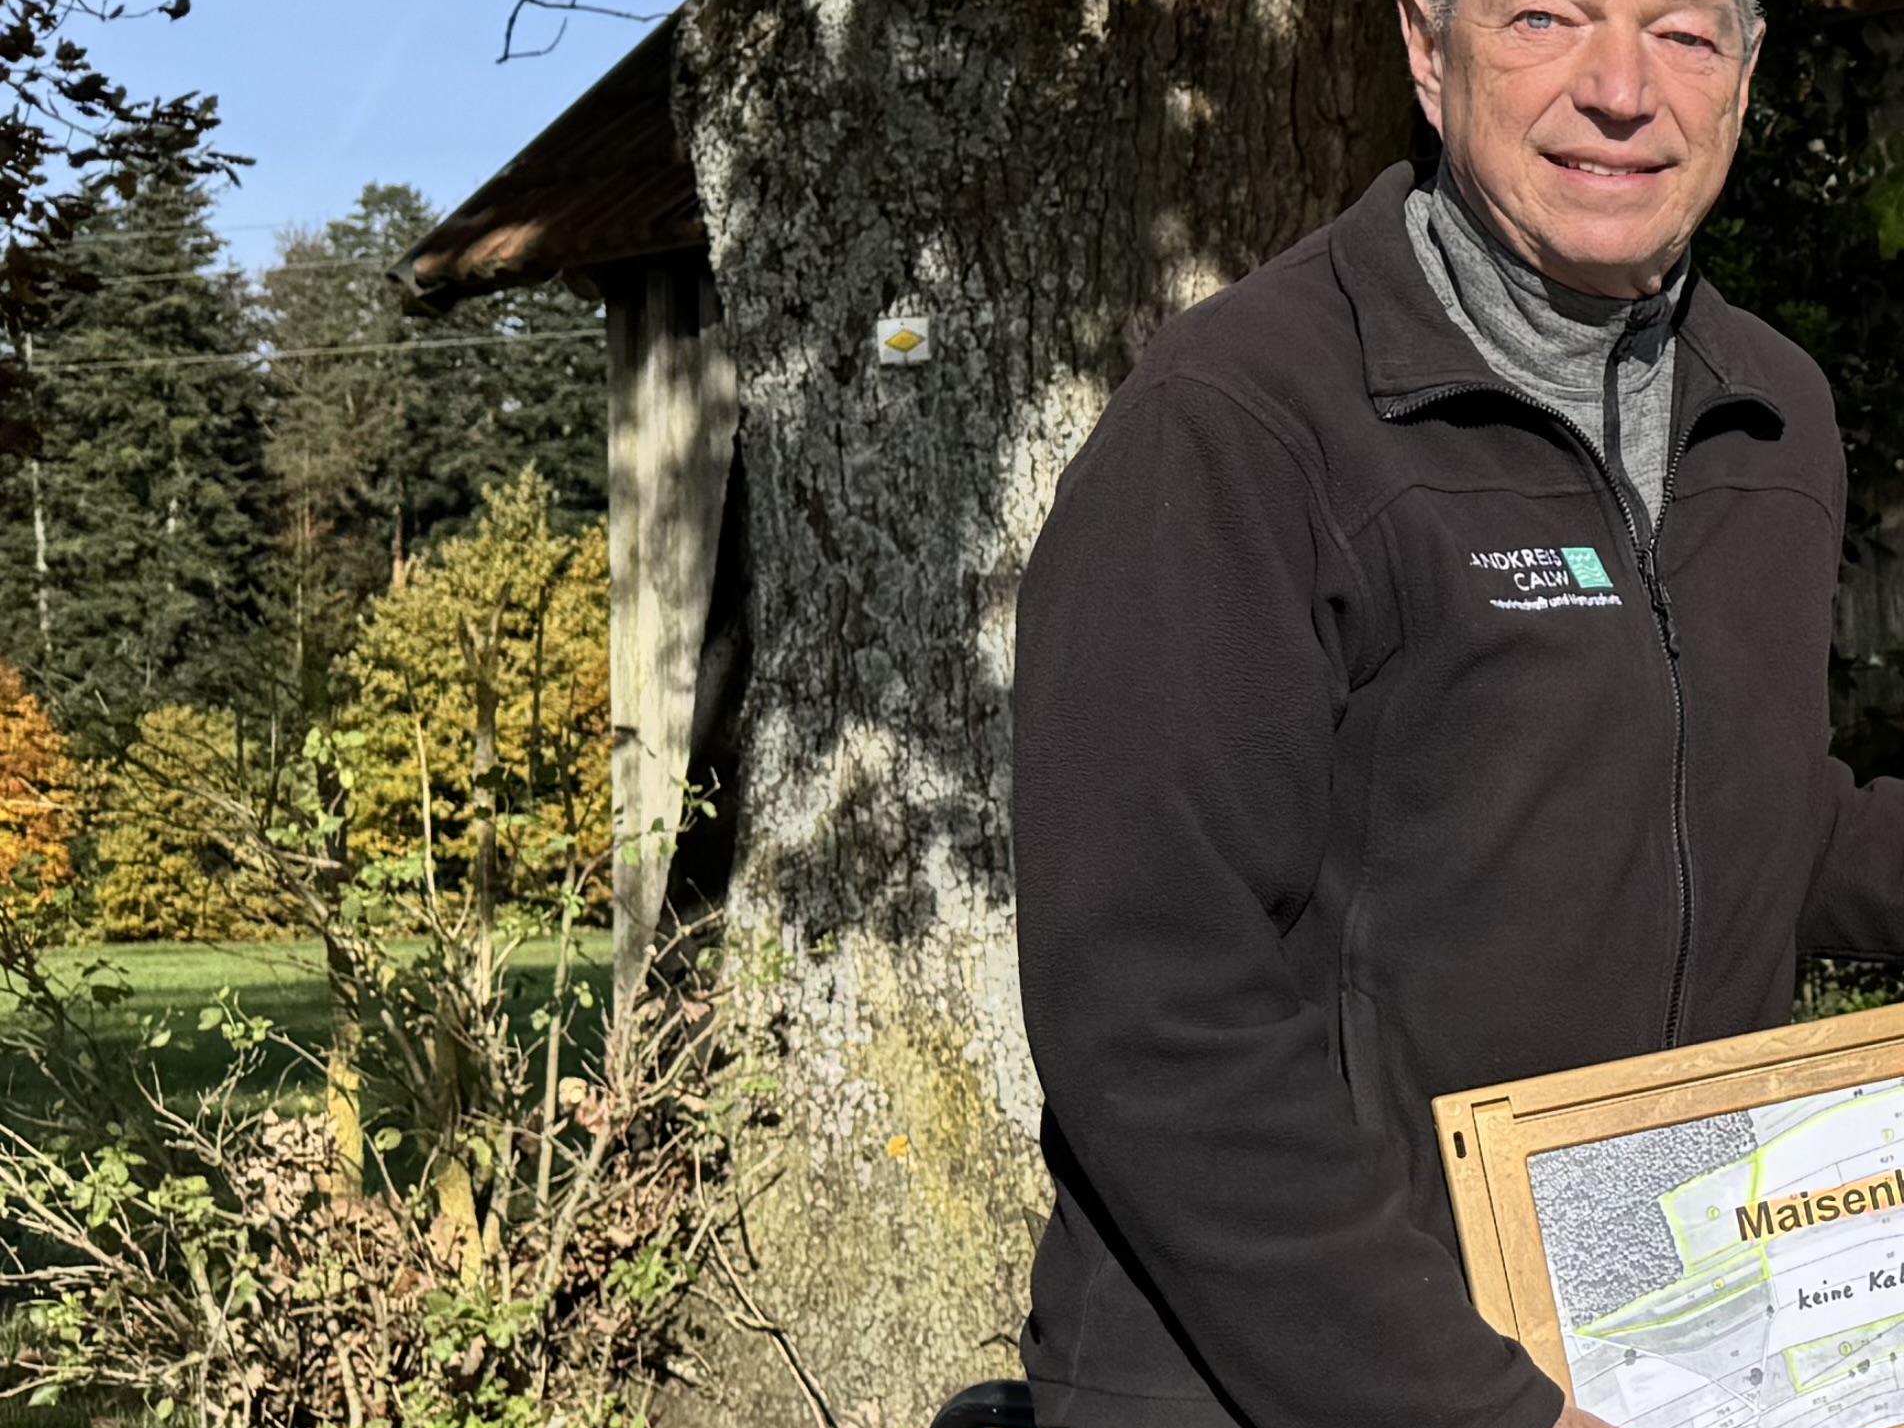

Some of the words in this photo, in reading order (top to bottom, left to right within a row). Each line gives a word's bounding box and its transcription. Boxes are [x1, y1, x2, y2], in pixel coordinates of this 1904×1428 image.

[1470, 548, 1562, 570] ANDKREIS
[1514, 570, 1569, 592] CALW
[1798, 1280, 1853, 1310] keine
